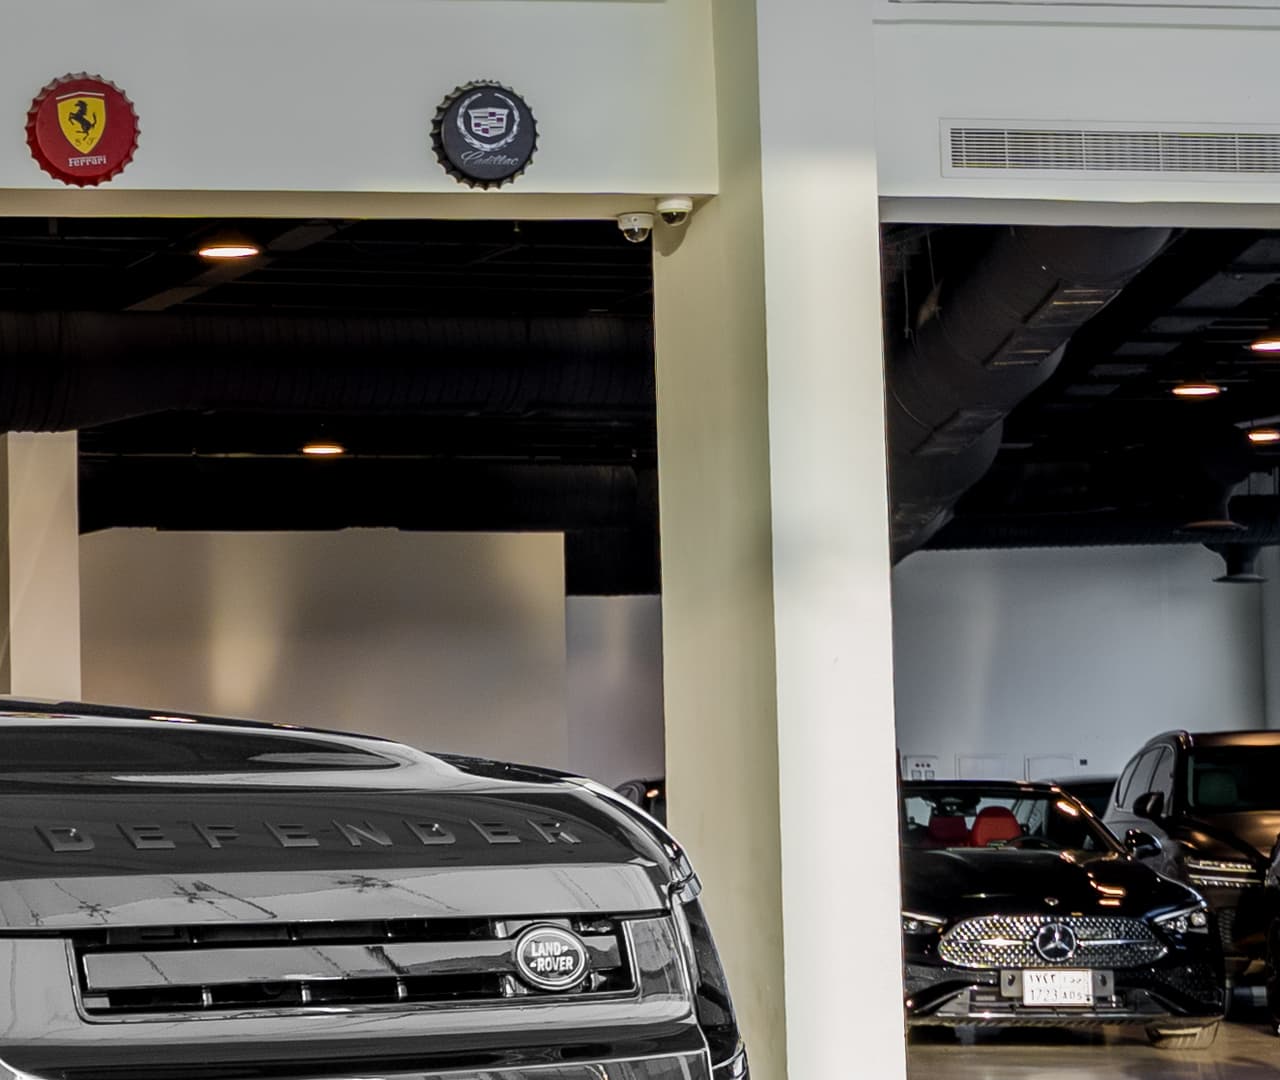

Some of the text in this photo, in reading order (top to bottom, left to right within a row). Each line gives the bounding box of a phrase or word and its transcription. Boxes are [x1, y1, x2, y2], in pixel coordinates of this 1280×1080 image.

[69, 155, 107, 167] Ferrari
[34, 818, 583, 852] DEFENDER
[531, 941, 562, 956] LAND
[537, 955, 573, 972] ROVER
